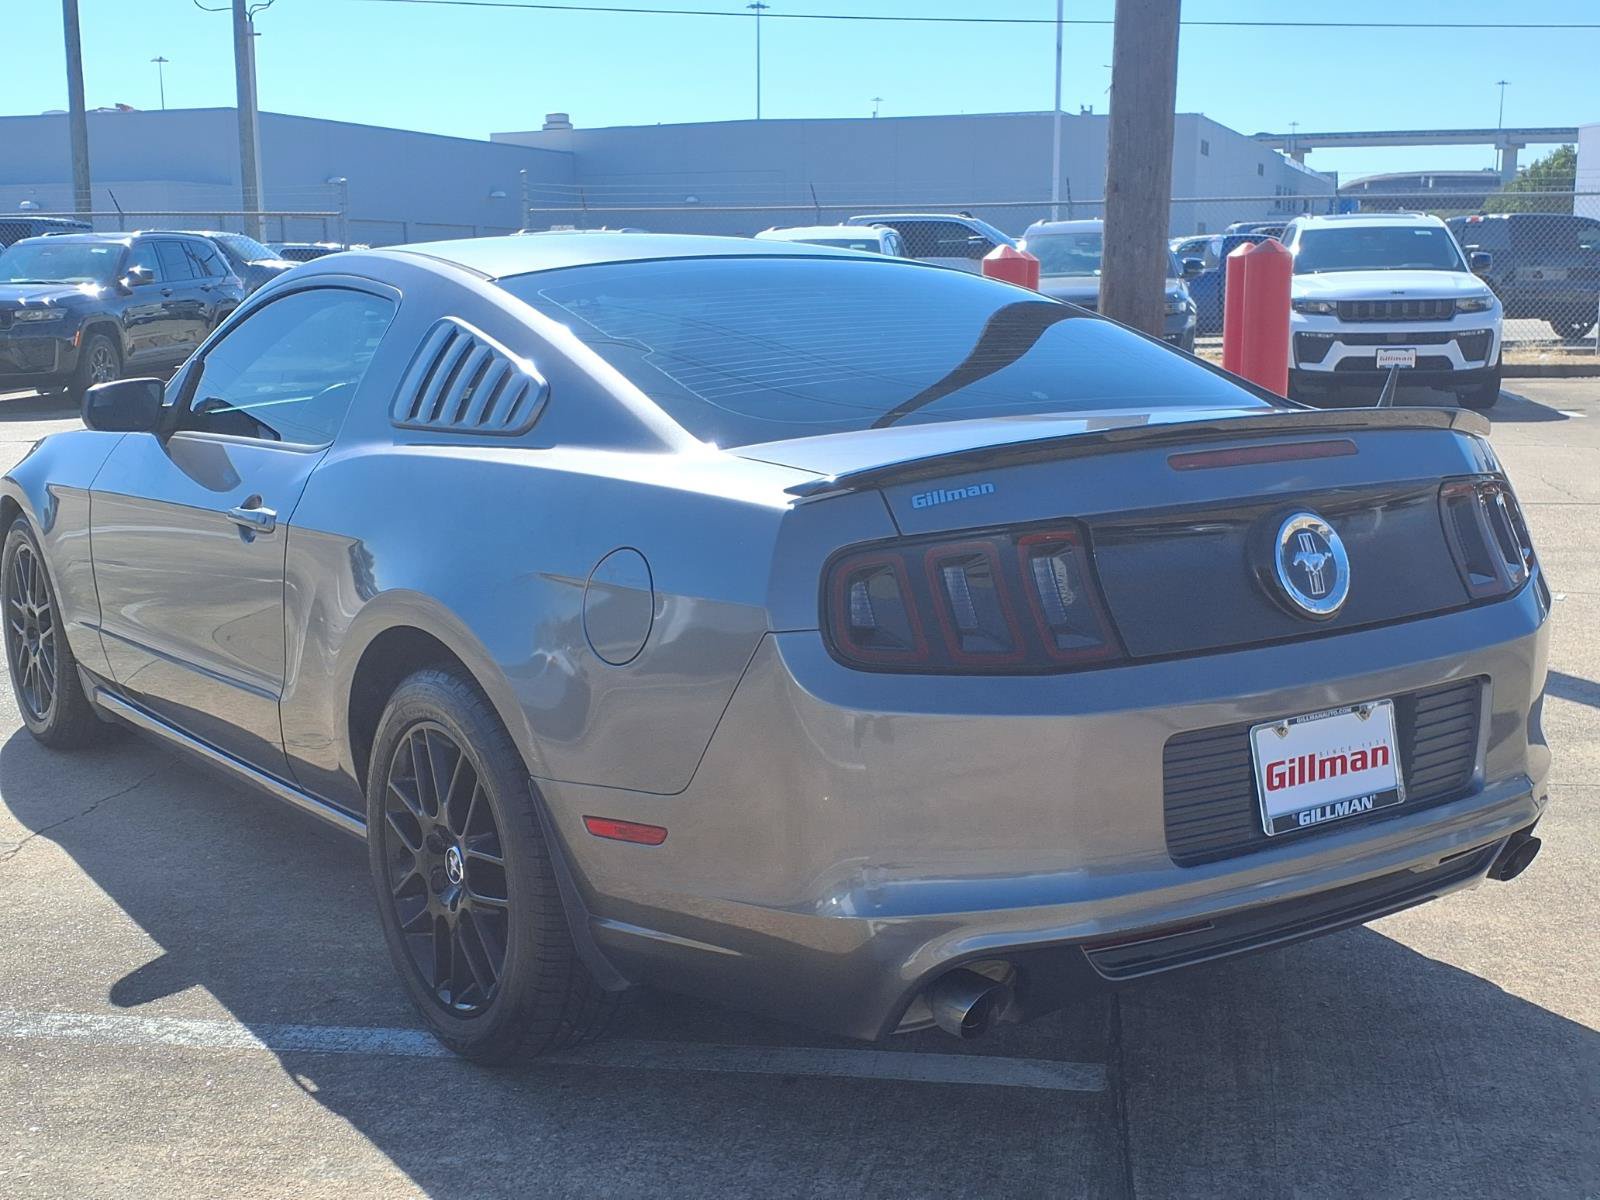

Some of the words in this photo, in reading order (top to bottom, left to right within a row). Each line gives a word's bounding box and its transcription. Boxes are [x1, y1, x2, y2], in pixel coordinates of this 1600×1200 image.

[912, 483, 995, 509] Gillman
[1266, 745, 1389, 792] Gillman
[1299, 795, 1374, 826] GILLMAN
